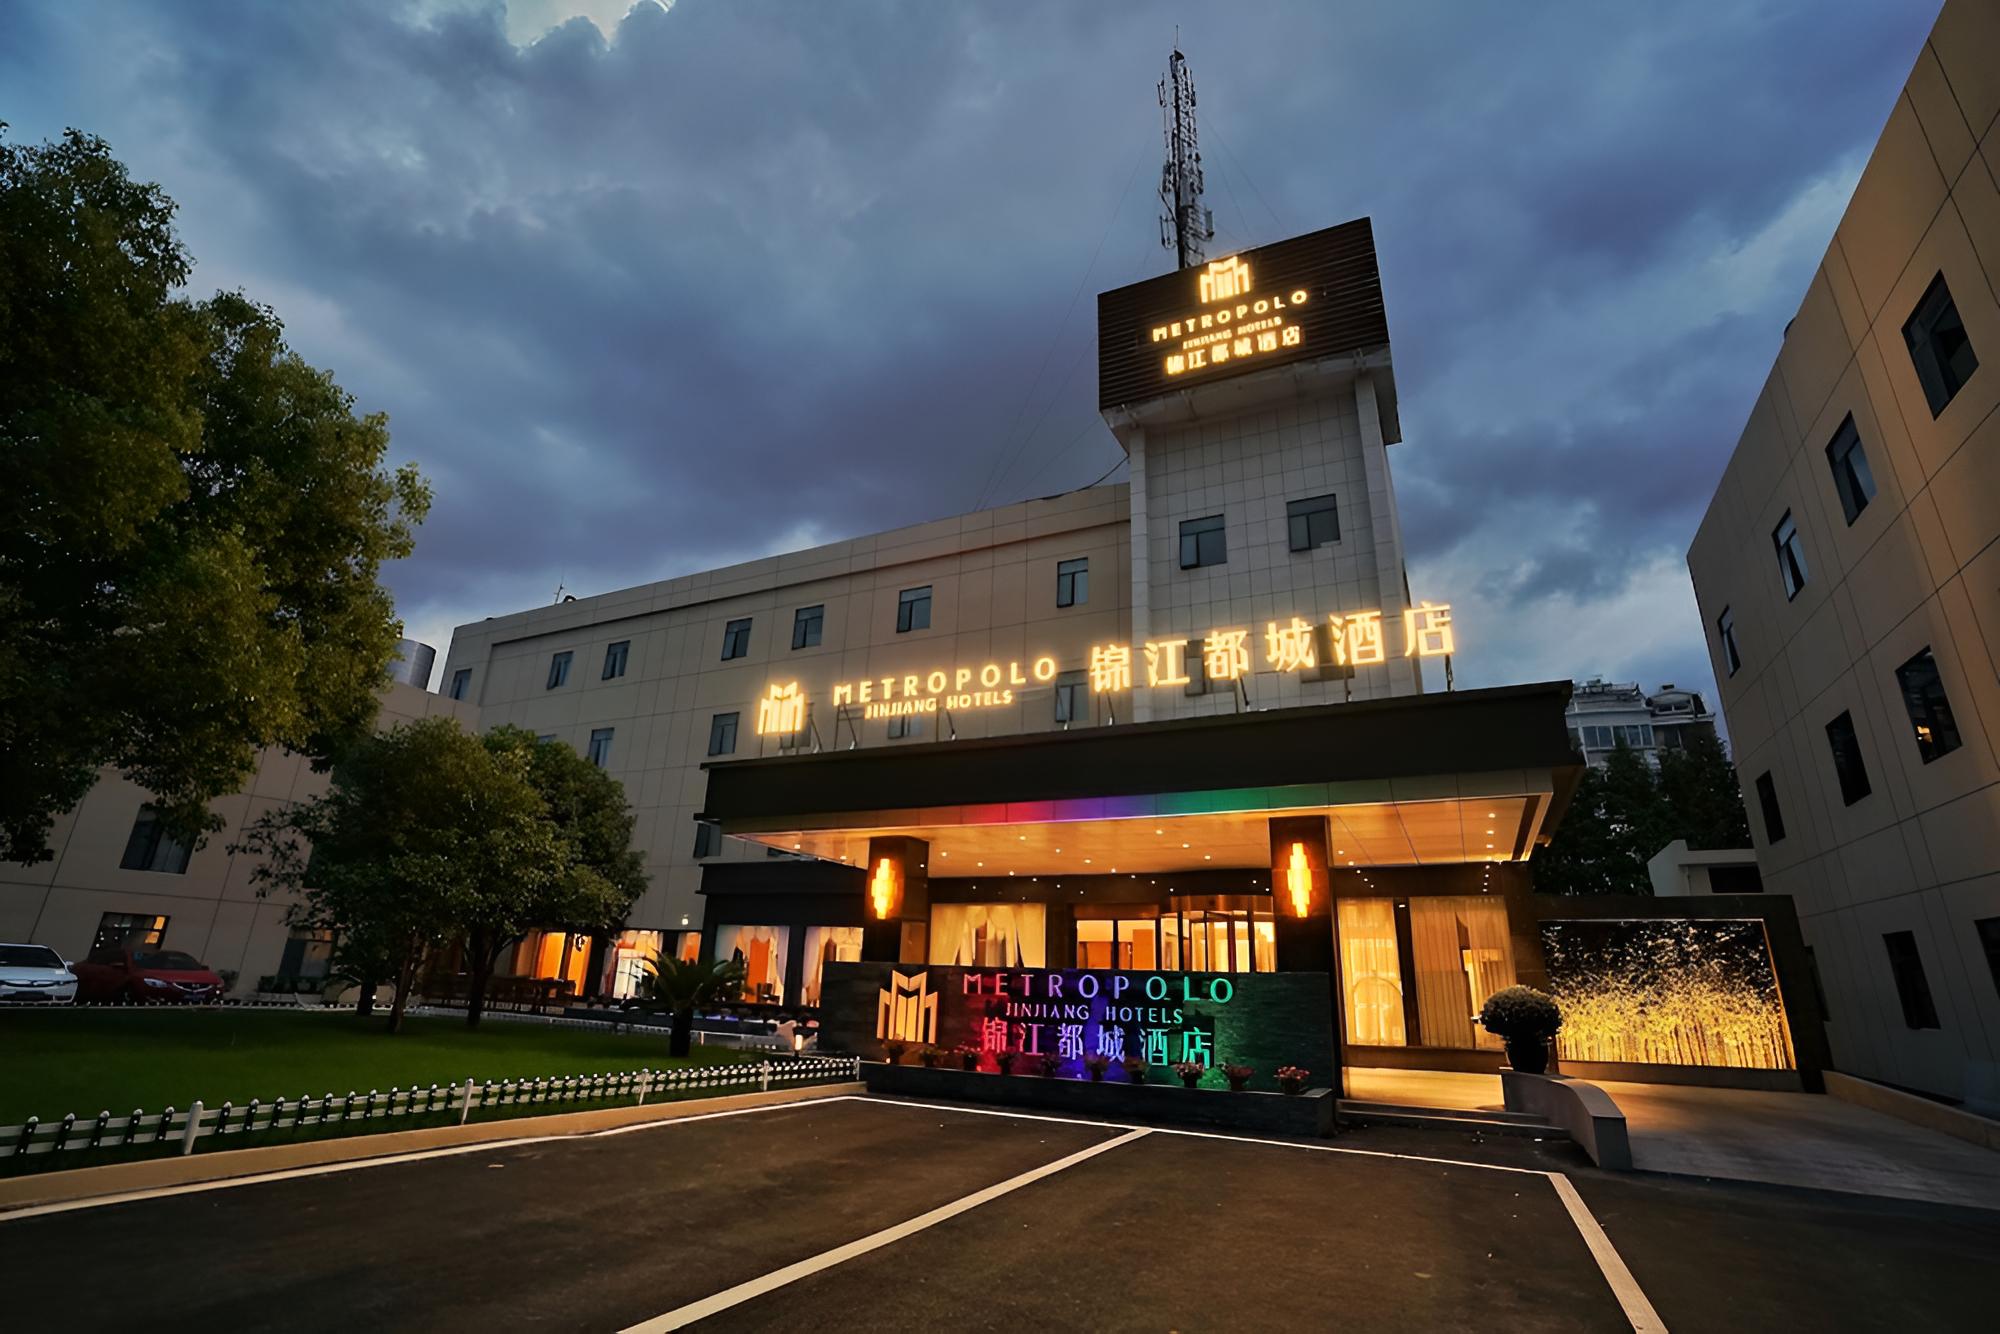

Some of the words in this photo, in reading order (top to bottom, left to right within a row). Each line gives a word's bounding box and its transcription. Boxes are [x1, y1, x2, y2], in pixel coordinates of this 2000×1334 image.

[1152, 290, 1308, 342] METROPOLO
[1089, 601, 1455, 693] 锦江都城酒店
[833, 657, 1056, 706] METROPOLO
[864, 697, 937, 720] JINJIANG
[946, 689, 1013, 710] HOTELS
[963, 973, 1234, 1004] METROPOLO
[1005, 1002, 1090, 1020] JINJIANG
[1105, 1006, 1184, 1024] HOTELS
[981, 1016, 1213, 1069] 锦江都城酒店
